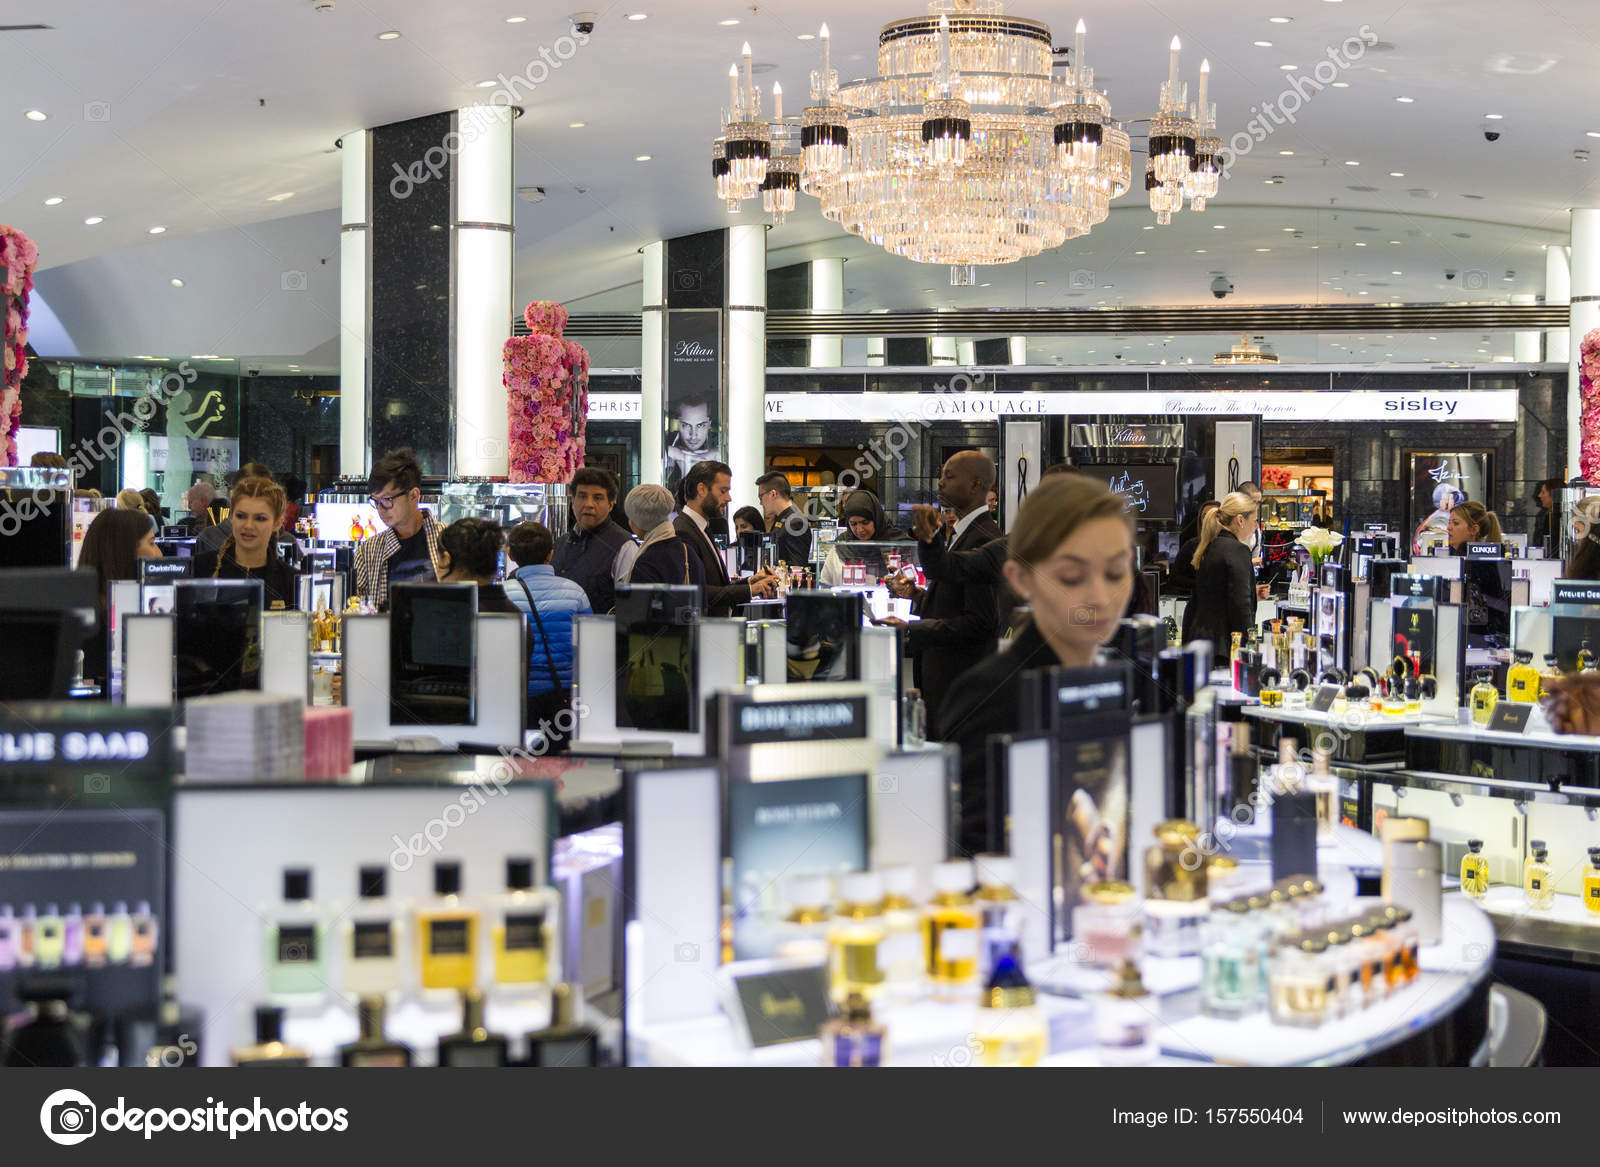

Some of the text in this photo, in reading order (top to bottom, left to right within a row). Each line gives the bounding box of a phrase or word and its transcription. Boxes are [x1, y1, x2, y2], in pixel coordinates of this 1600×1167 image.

[674, 341, 714, 356] Kilian
[589, 401, 640, 412] CHRIST
[935, 400, 1047, 413] AMOUAGE
[1385, 397, 1458, 414] sisley
[1112, 427, 1146, 442] Kilian
[1472, 546, 1497, 554] CLINIQUE
[0, 731, 55, 761] LIE
